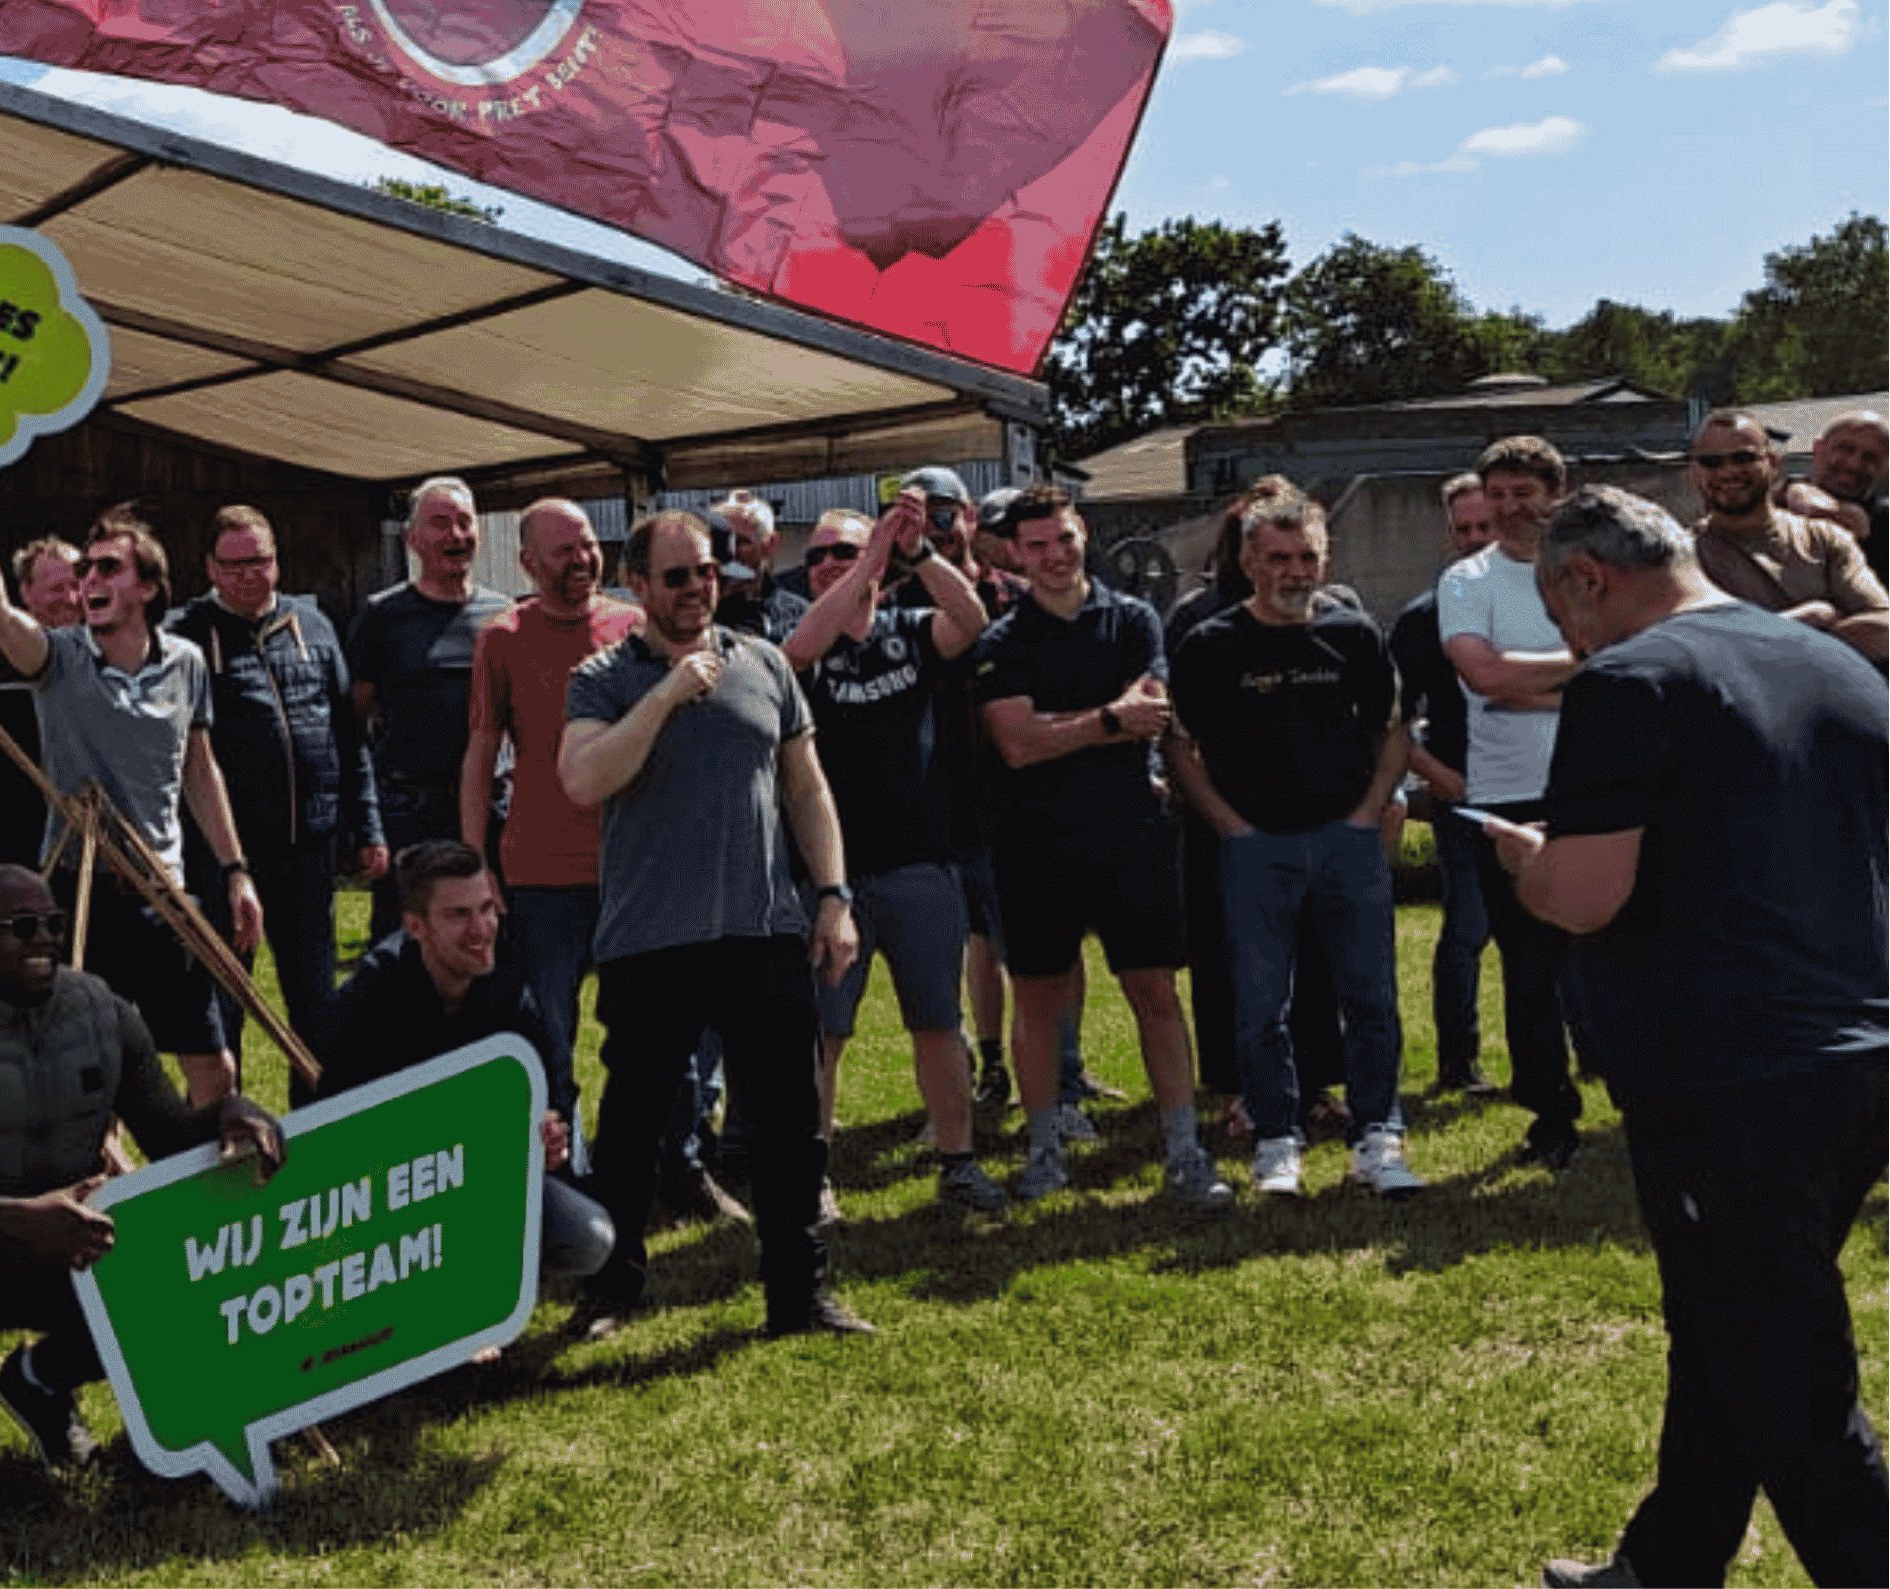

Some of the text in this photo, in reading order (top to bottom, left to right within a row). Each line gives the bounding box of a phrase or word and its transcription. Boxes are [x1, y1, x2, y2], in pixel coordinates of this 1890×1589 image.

[477, 84, 541, 122] PRET
[184, 1143, 465, 1282] WIJ ZIJN EEN
[219, 1223, 443, 1346] TOPTEAM!
